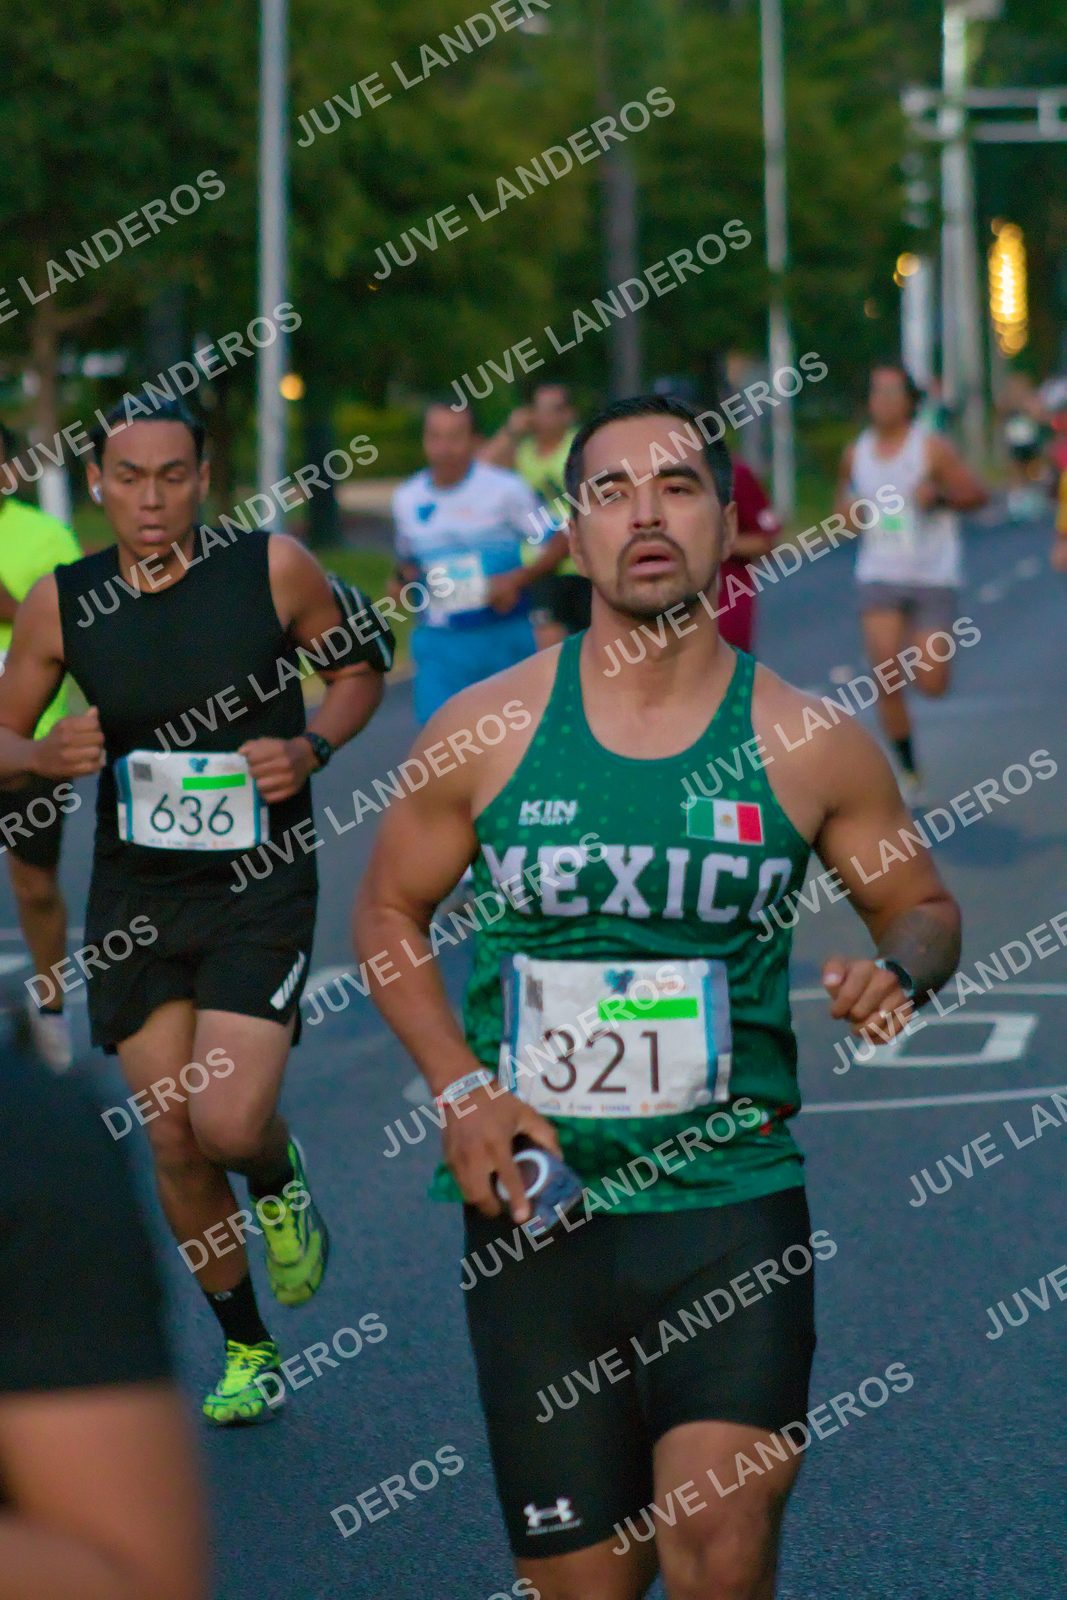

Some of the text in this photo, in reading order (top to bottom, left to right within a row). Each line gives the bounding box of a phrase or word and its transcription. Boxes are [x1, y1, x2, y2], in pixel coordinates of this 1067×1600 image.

[151, 794, 234, 836] 636
[520, 799, 577, 816] KIN
[541, 1028, 660, 1094] 321
